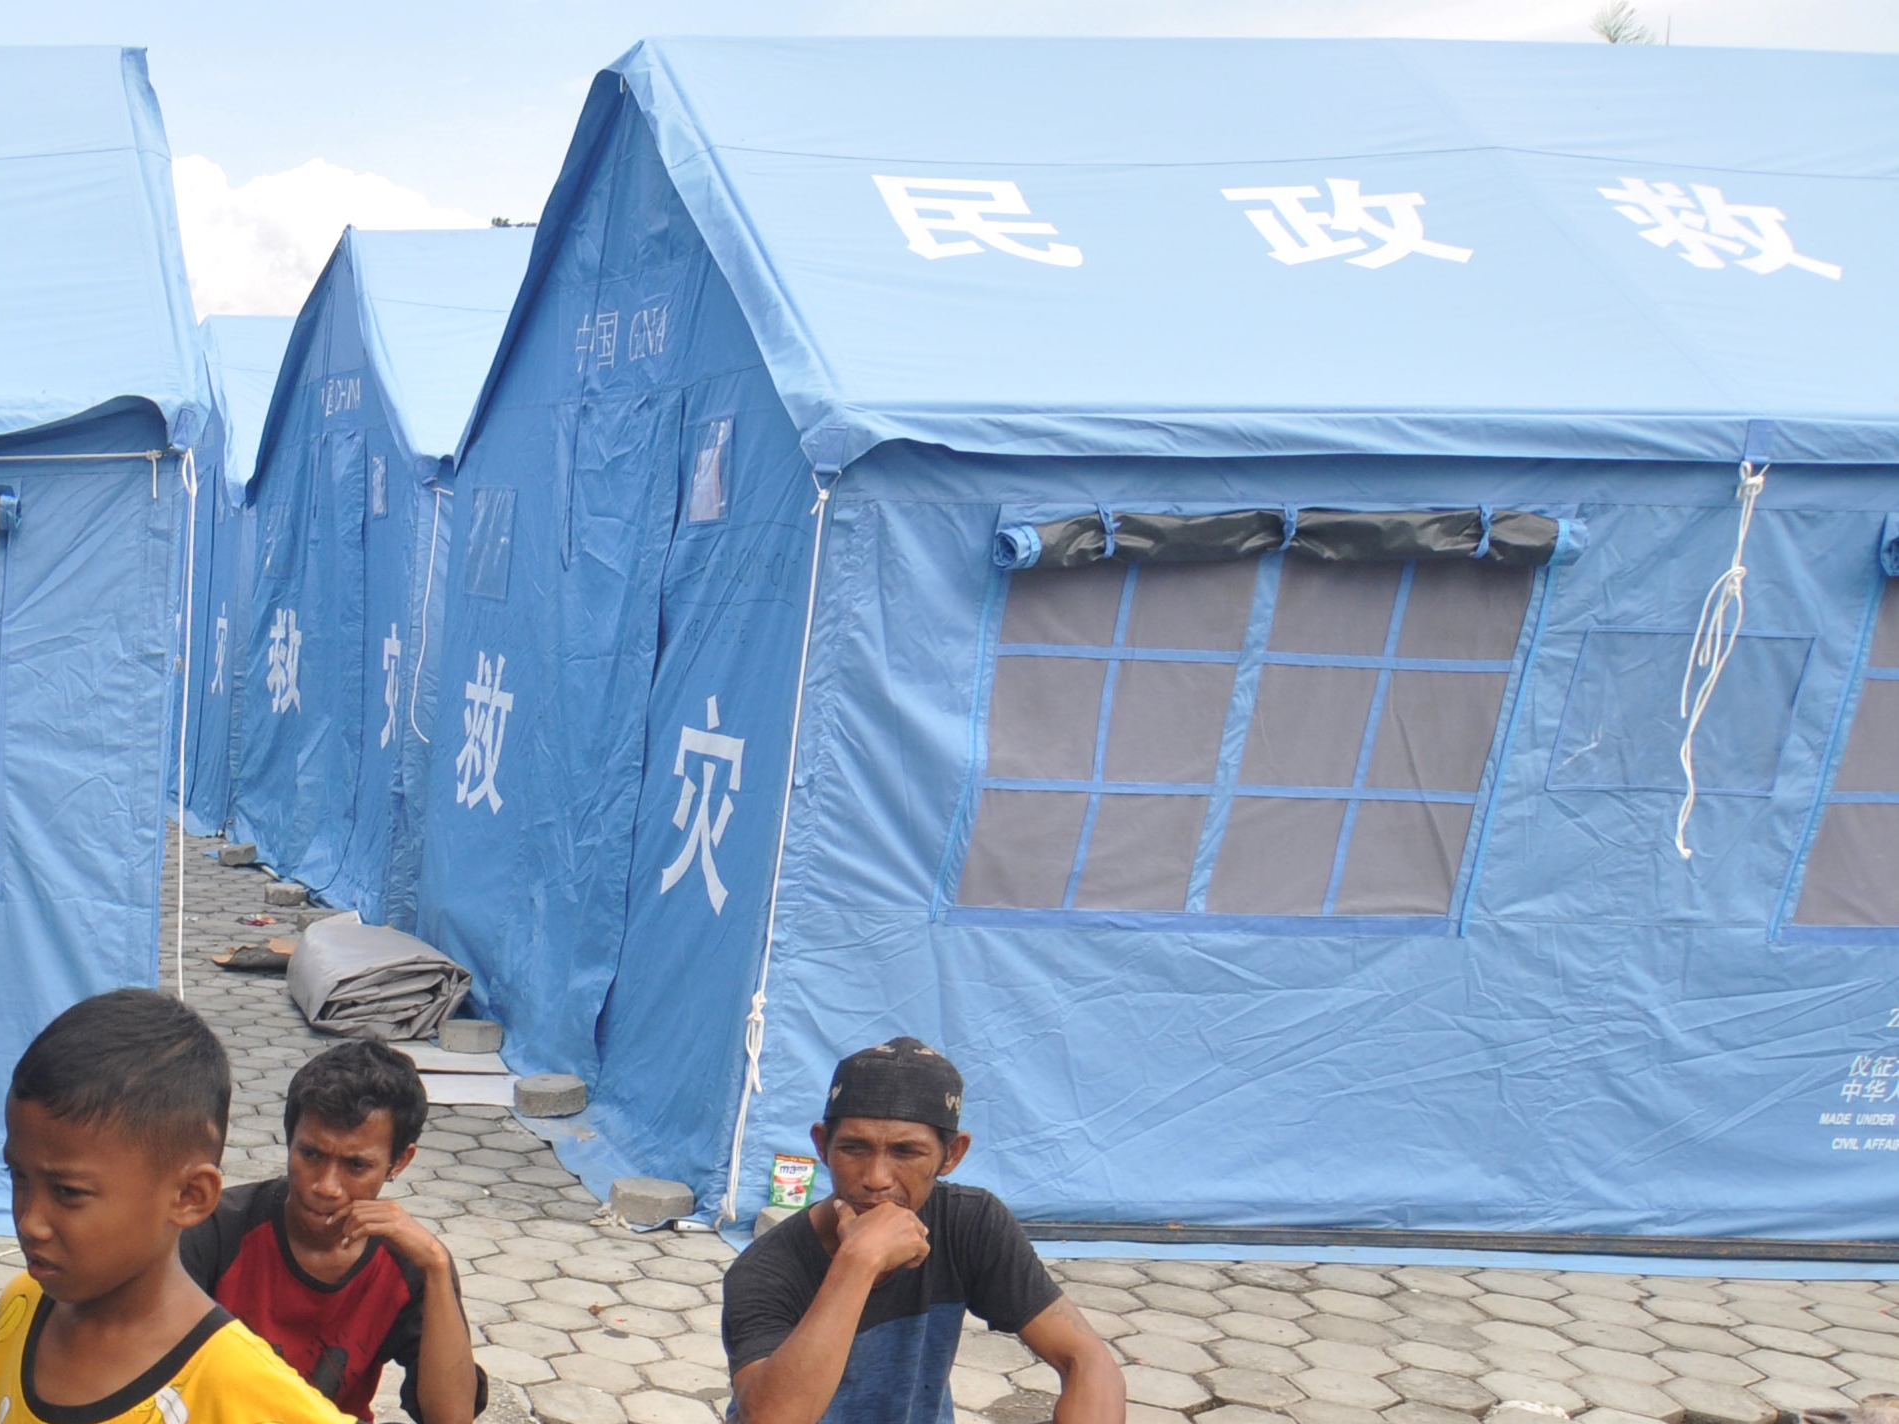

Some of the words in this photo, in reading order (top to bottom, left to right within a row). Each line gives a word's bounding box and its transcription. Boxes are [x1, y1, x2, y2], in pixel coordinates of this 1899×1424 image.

[455, 650, 514, 816] 救
[660, 695, 745, 916] 灾
[1819, 1113, 1852, 1126] MADE
[1855, 1113, 1896, 1127] UNDER
[1831, 1137, 1860, 1151] CIVIL
